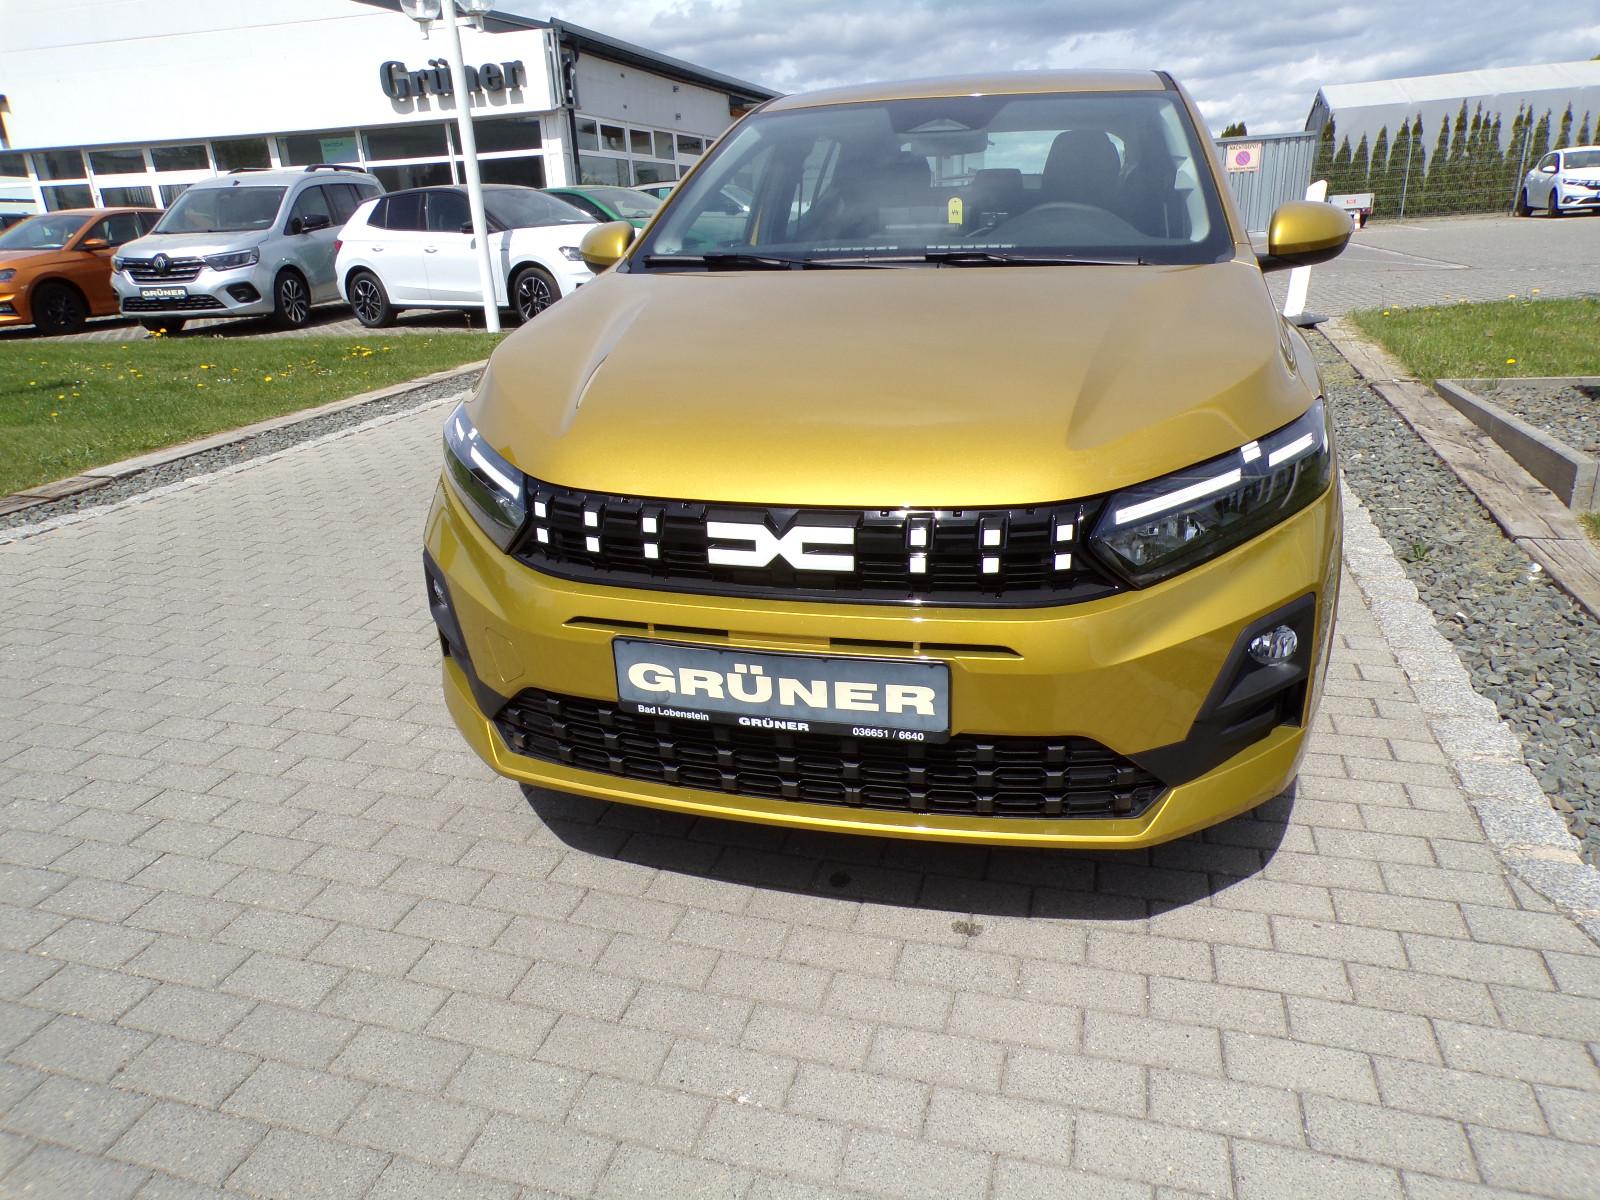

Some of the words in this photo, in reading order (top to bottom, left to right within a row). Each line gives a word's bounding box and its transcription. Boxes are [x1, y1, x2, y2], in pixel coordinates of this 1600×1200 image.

[380, 58, 527, 100] Grüner
[142, 288, 186, 297] GRÜNER
[628, 663, 936, 716] GRÜNER
[637, 704, 656, 714] Bad
[657, 706, 710, 721] Lobenstein
[738, 717, 810, 732] GRÜNER
[852, 727, 889, 738] 036651
[898, 731, 925, 741] 6640
